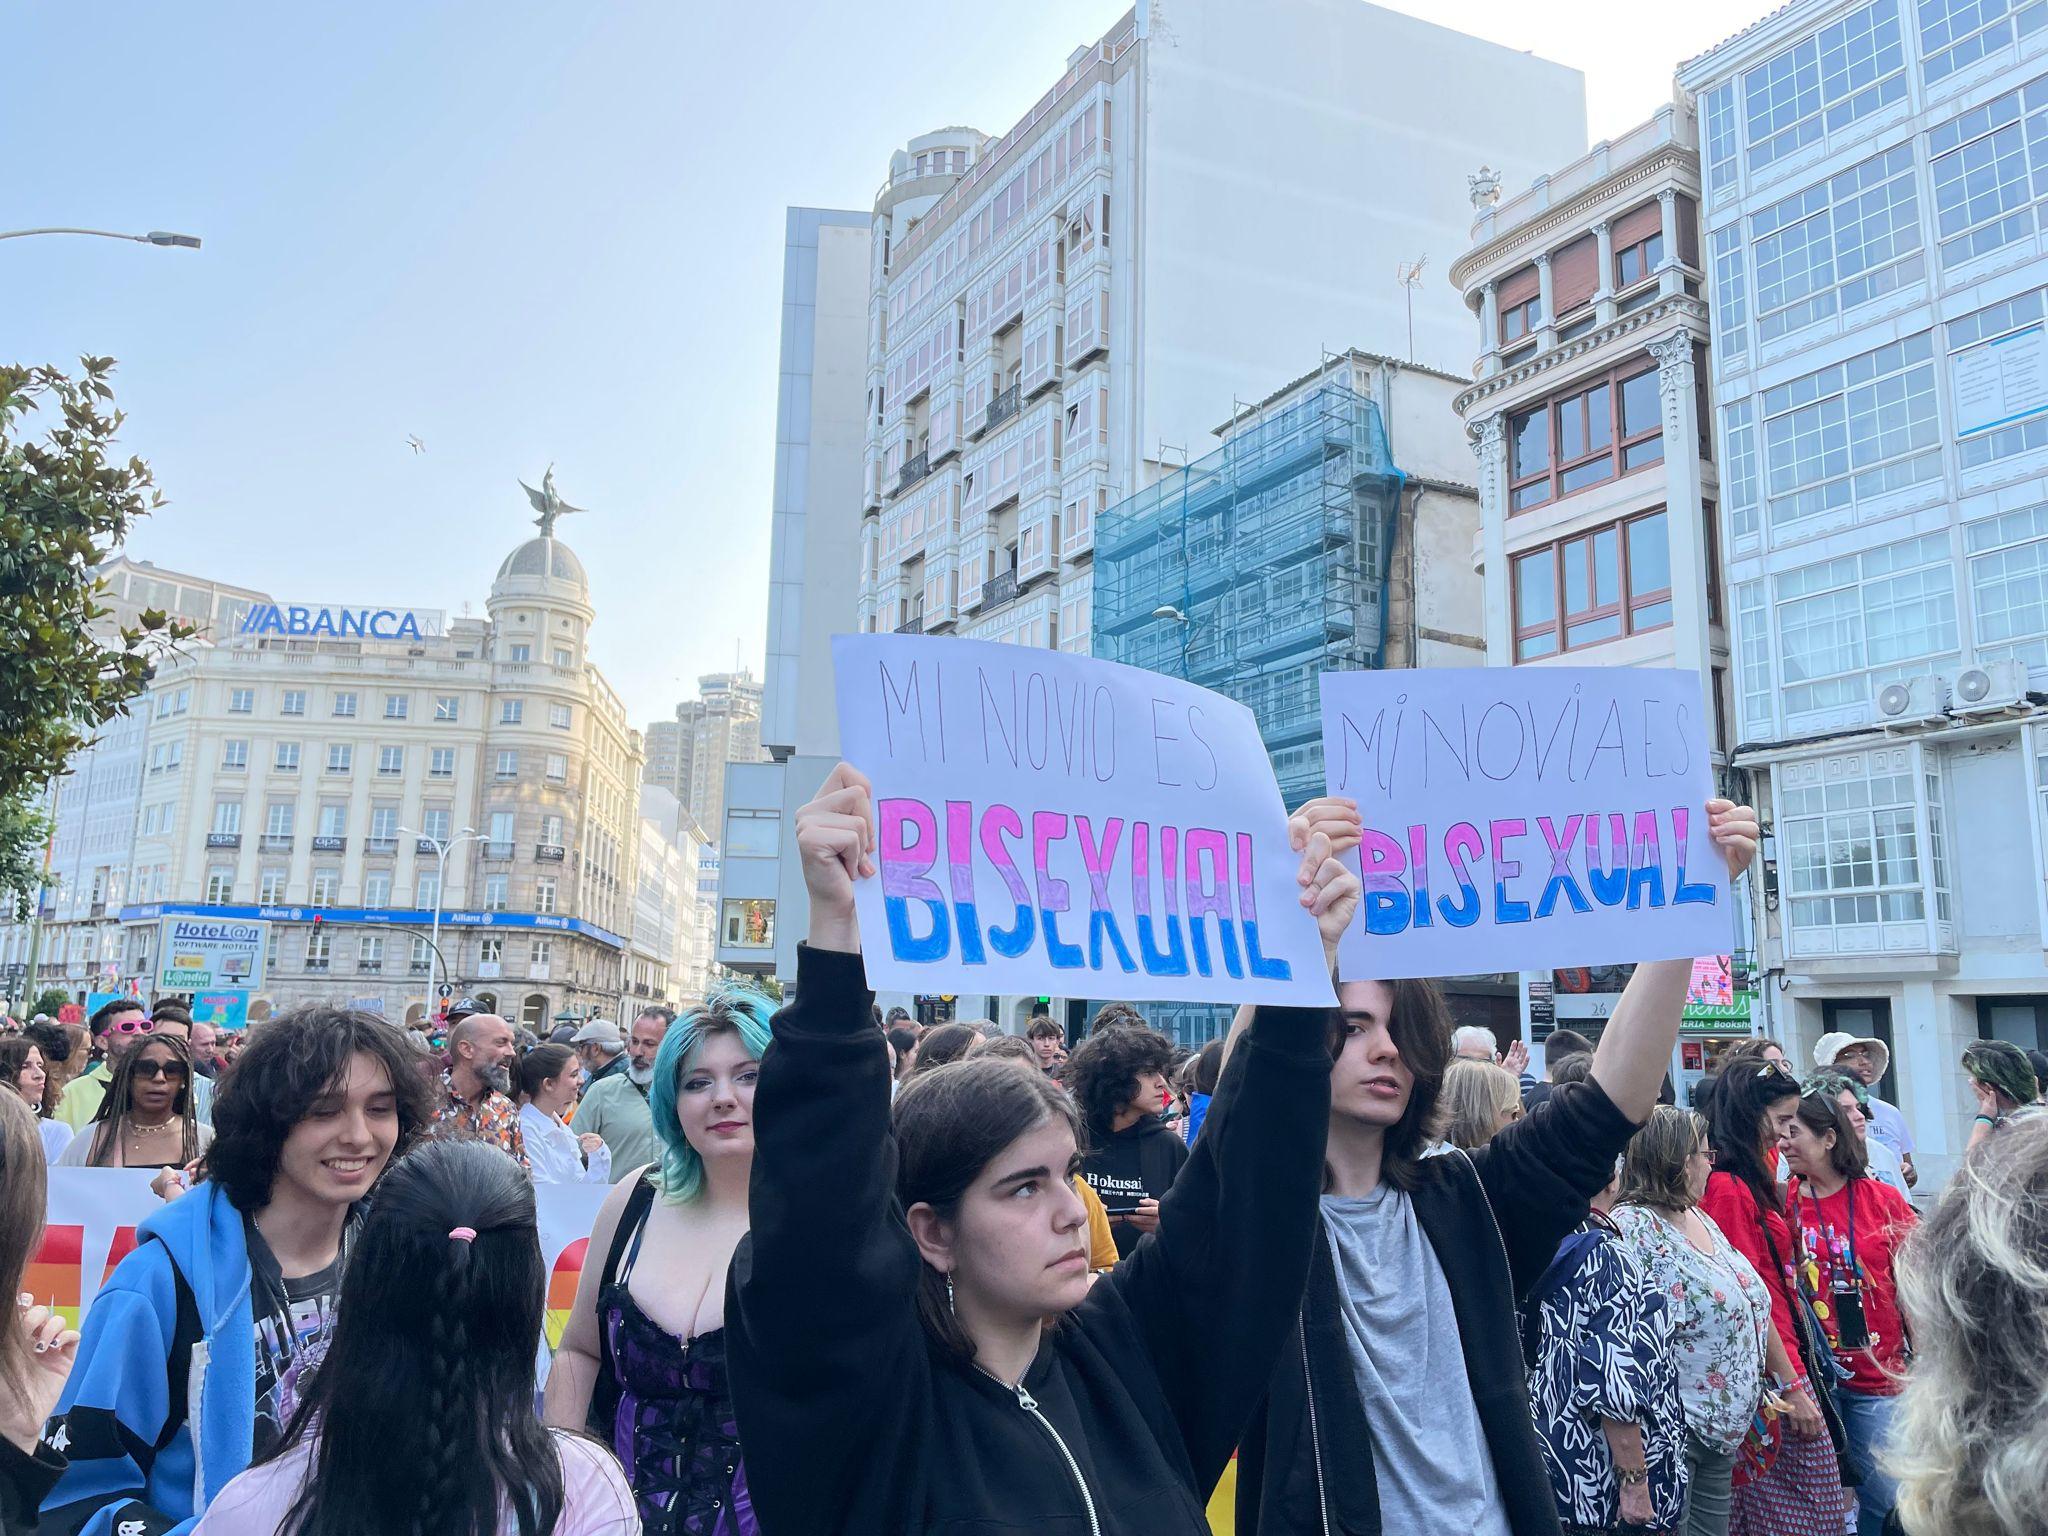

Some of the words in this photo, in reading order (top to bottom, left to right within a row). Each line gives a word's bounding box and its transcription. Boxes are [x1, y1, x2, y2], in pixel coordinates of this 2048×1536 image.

[258, 604, 423, 641] ABANCA
[878, 659, 946, 764] MI
[977, 665, 1116, 783] NOVIO
[1151, 698, 1219, 792] ES
[1358, 805, 1718, 936] BISEXUAL
[877, 797, 1293, 982] BISEXUAL
[259, 908, 290, 918] Allianz
[451, 913, 481, 923] Allianz
[535, 915, 561, 927] Allianz
[173, 941, 219, 949] SOFTWARE
[222, 943, 259, 951] HOTELES
[1592, 1002, 1607, 1016] 26
[1680, 1020, 1705, 1028] ERIA
[1714, 1020, 1751, 1029] Booksho
[1086, 1173, 1142, 1189] Hokusai
